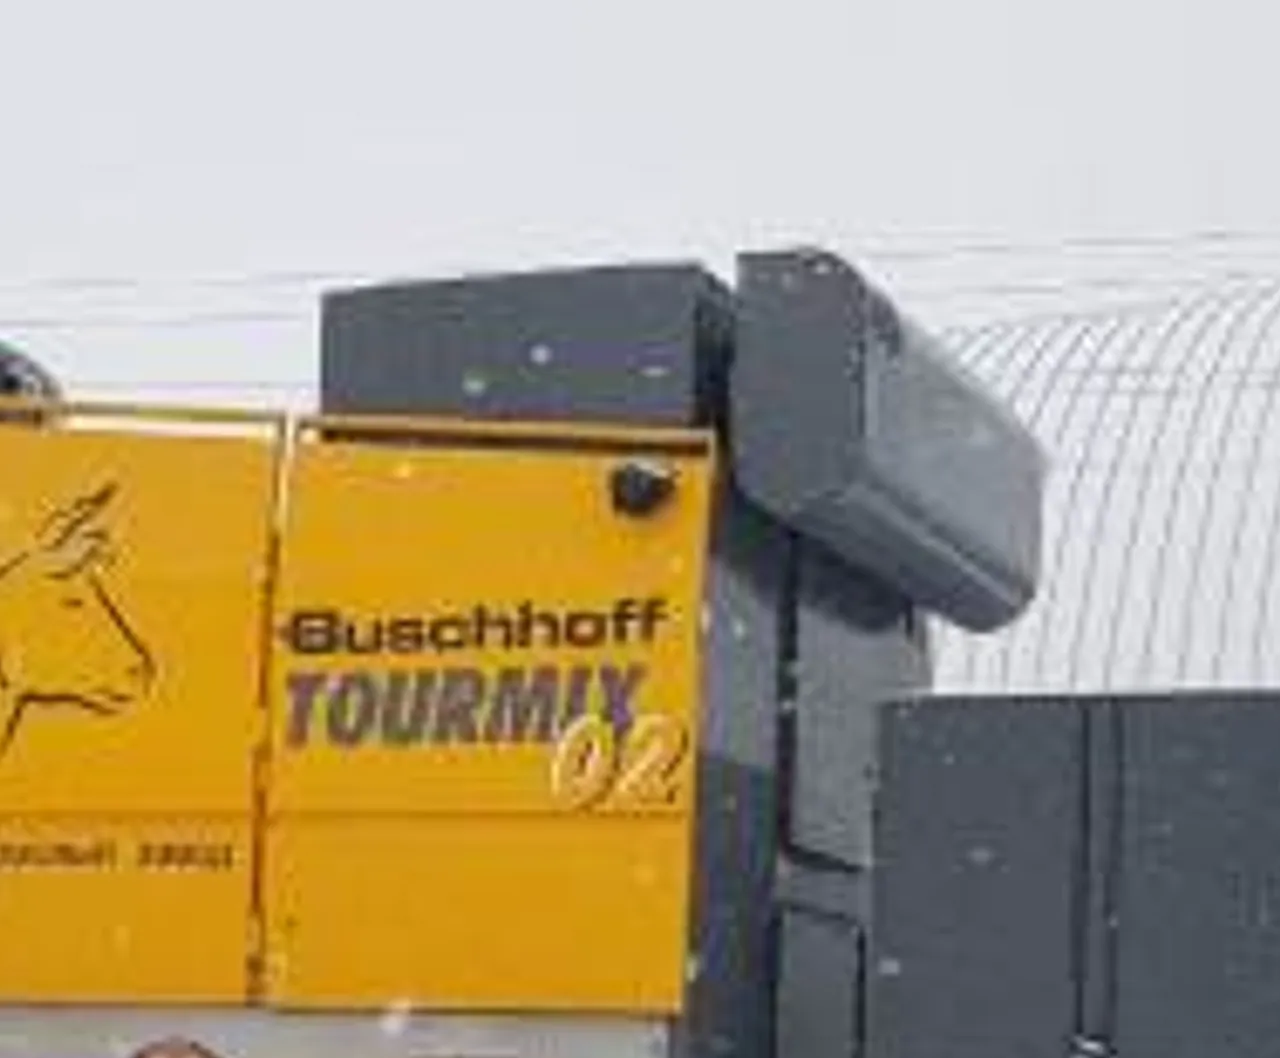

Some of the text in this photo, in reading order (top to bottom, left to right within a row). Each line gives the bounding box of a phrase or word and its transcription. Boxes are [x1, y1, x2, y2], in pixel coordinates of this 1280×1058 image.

[282, 598, 670, 656] Buschhoff
[284, 664, 650, 752] TOURMIX
[551, 711, 690, 814] 02
